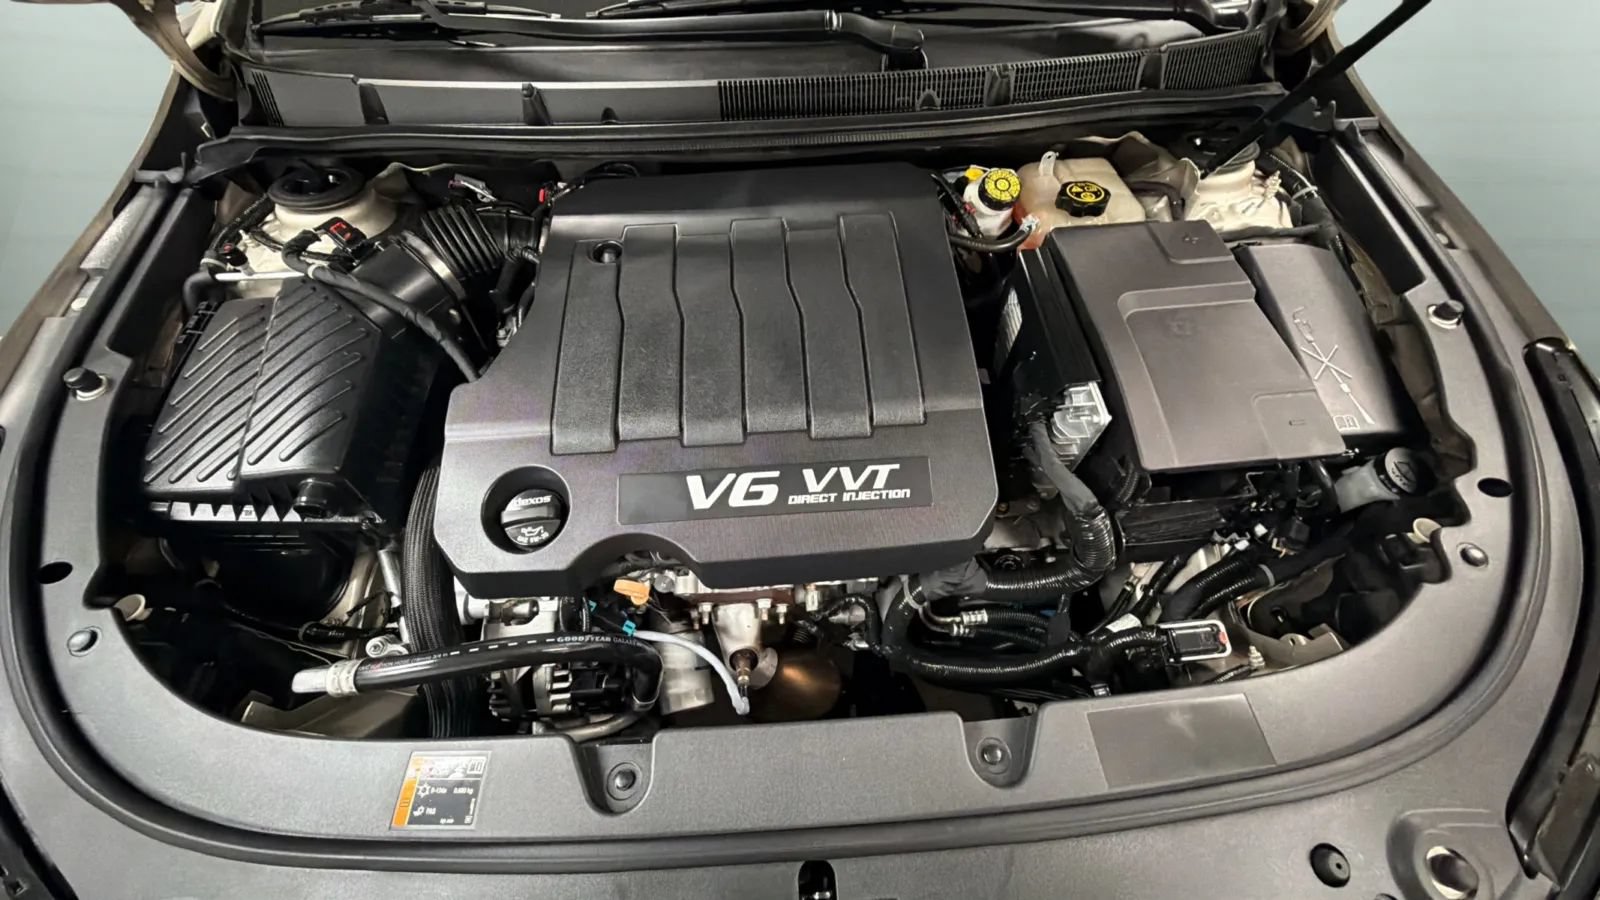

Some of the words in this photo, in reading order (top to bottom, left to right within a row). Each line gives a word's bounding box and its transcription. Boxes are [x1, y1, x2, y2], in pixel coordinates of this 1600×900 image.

[686, 470, 781, 510] V6
[802, 463, 900, 493] VVT
[514, 495, 552, 506] dexos
[788, 492, 838, 505] DIRECT
[842, 489, 911, 502] INJECTION
[557, 634, 612, 643] GOODYEAR
